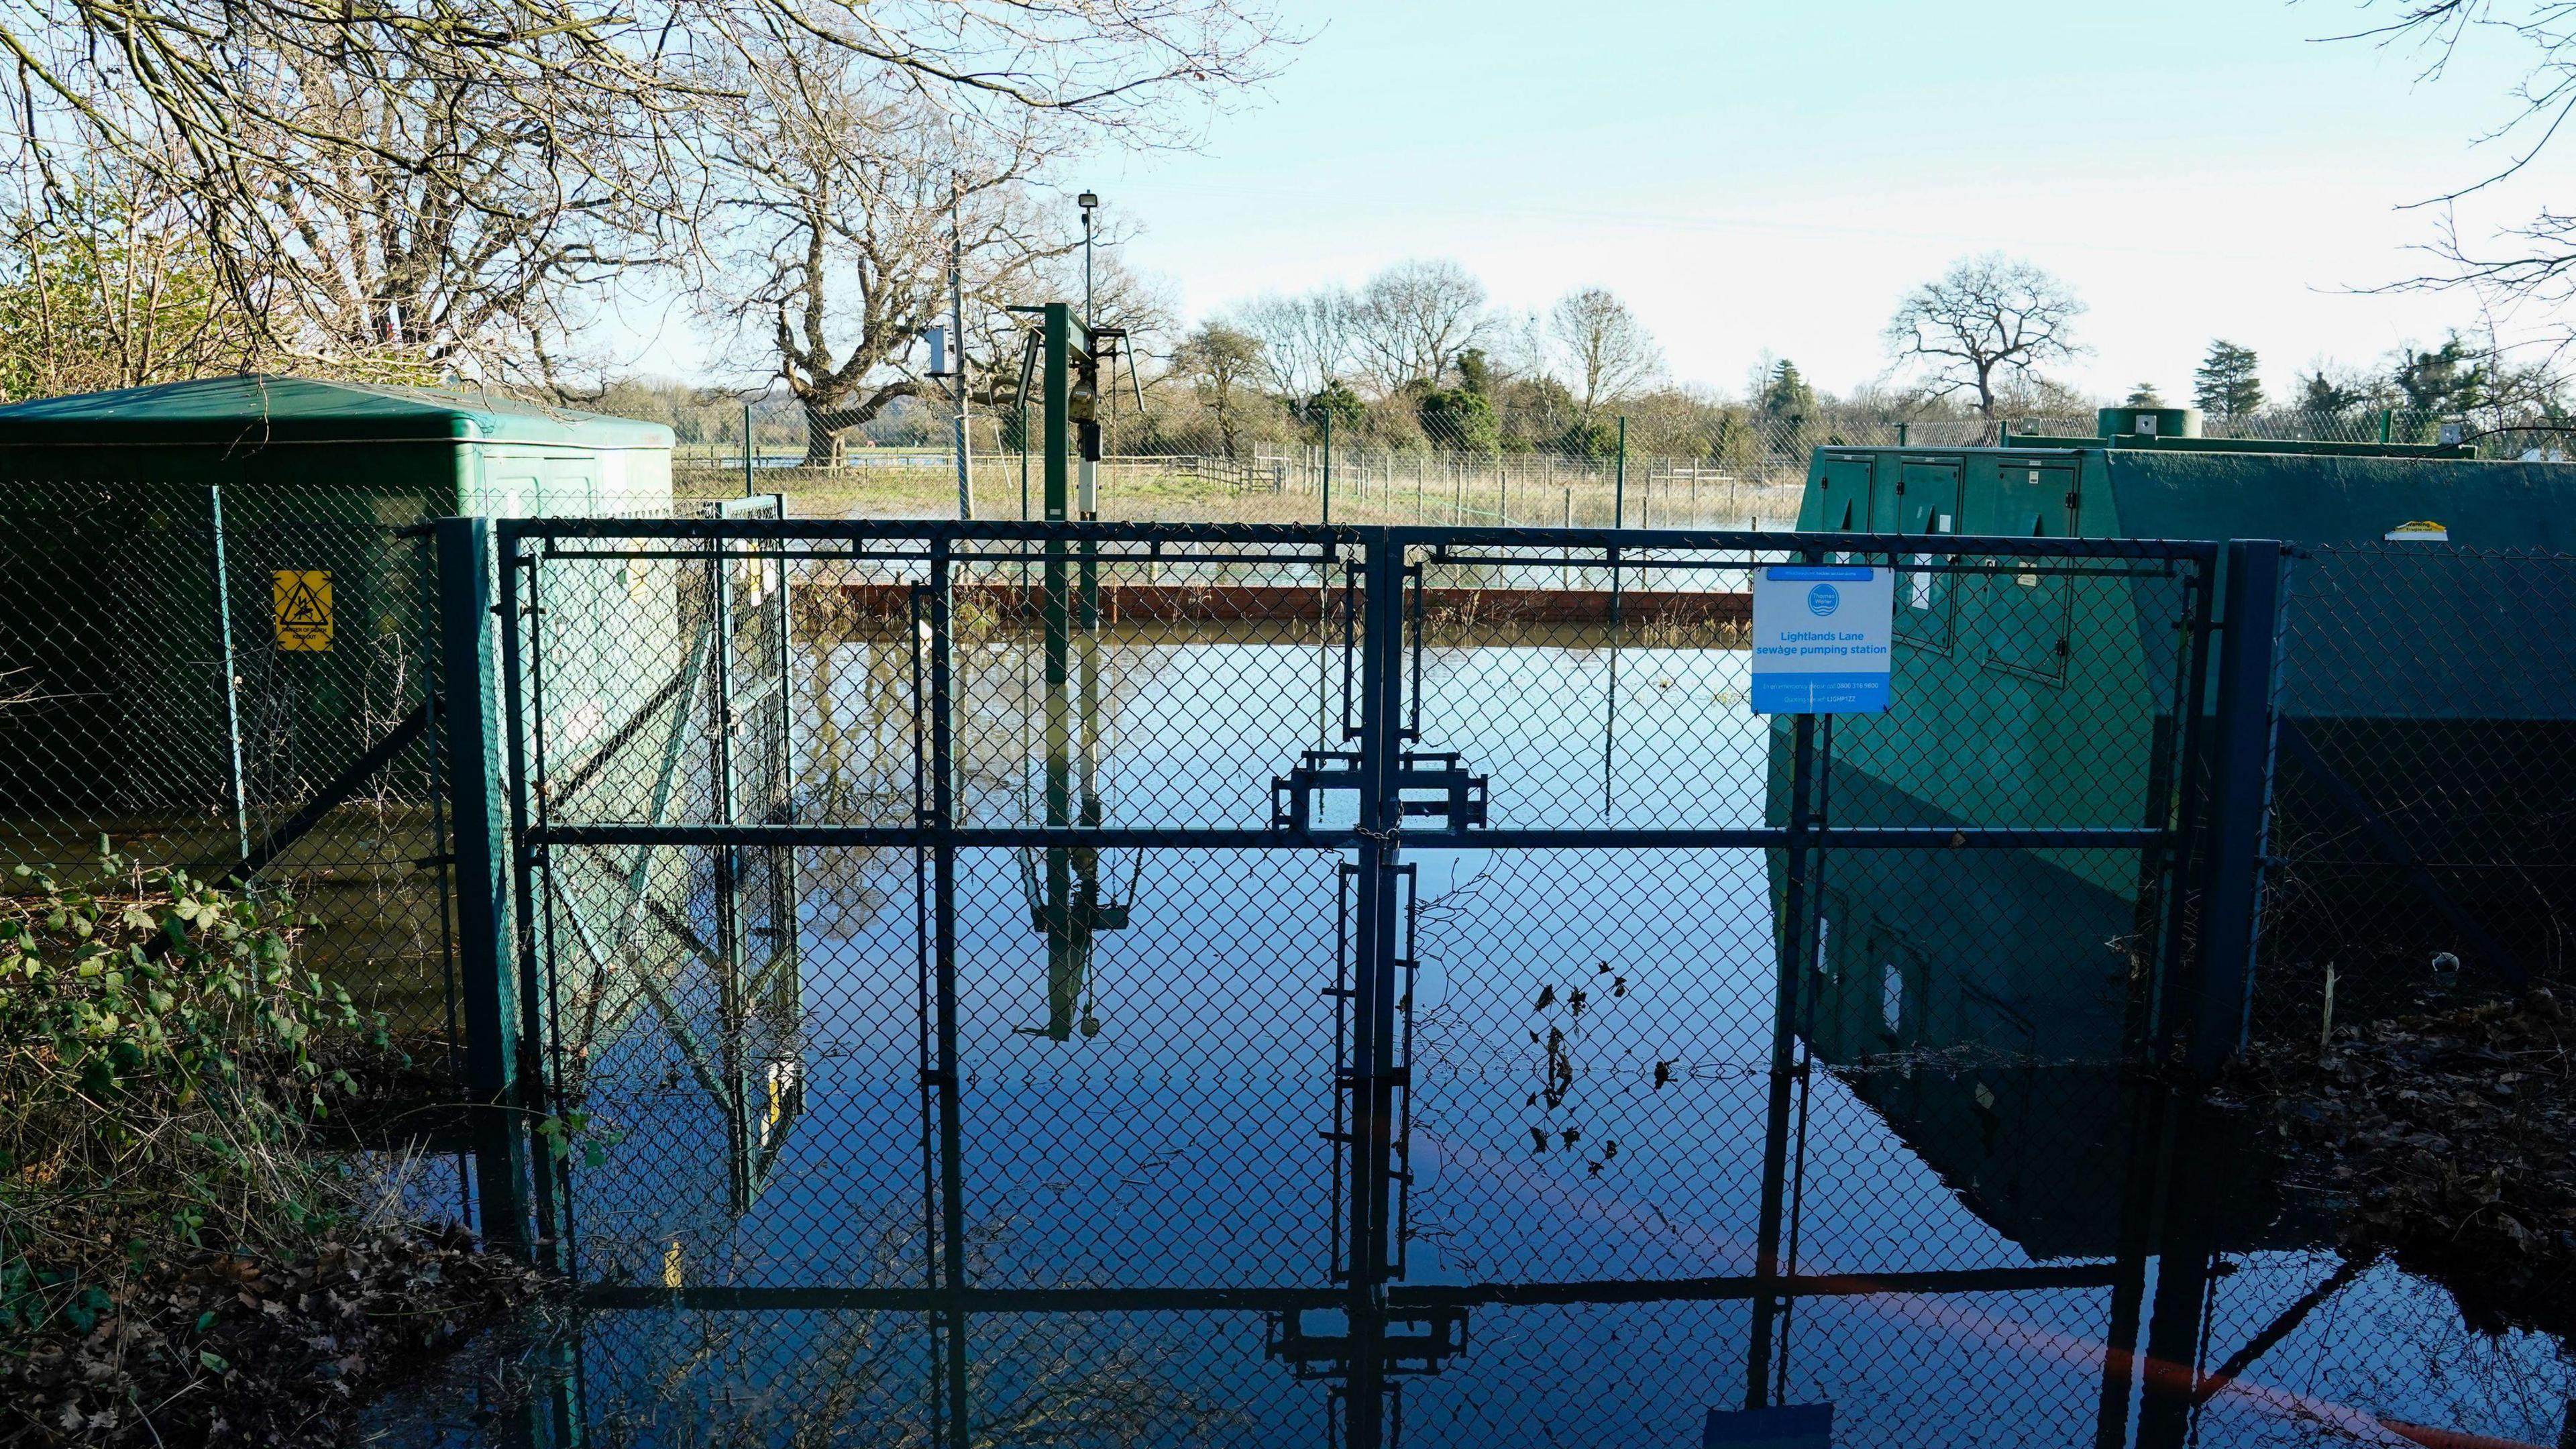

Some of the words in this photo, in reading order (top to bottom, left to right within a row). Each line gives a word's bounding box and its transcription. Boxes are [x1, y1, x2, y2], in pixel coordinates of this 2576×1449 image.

[1780, 631, 1836, 642] Lightlands
[1839, 632, 1864, 641] Lane
[1756, 646, 1797, 655] sewage
[1801, 645, 1847, 655] pumping
[1850, 645, 1887, 654] station
